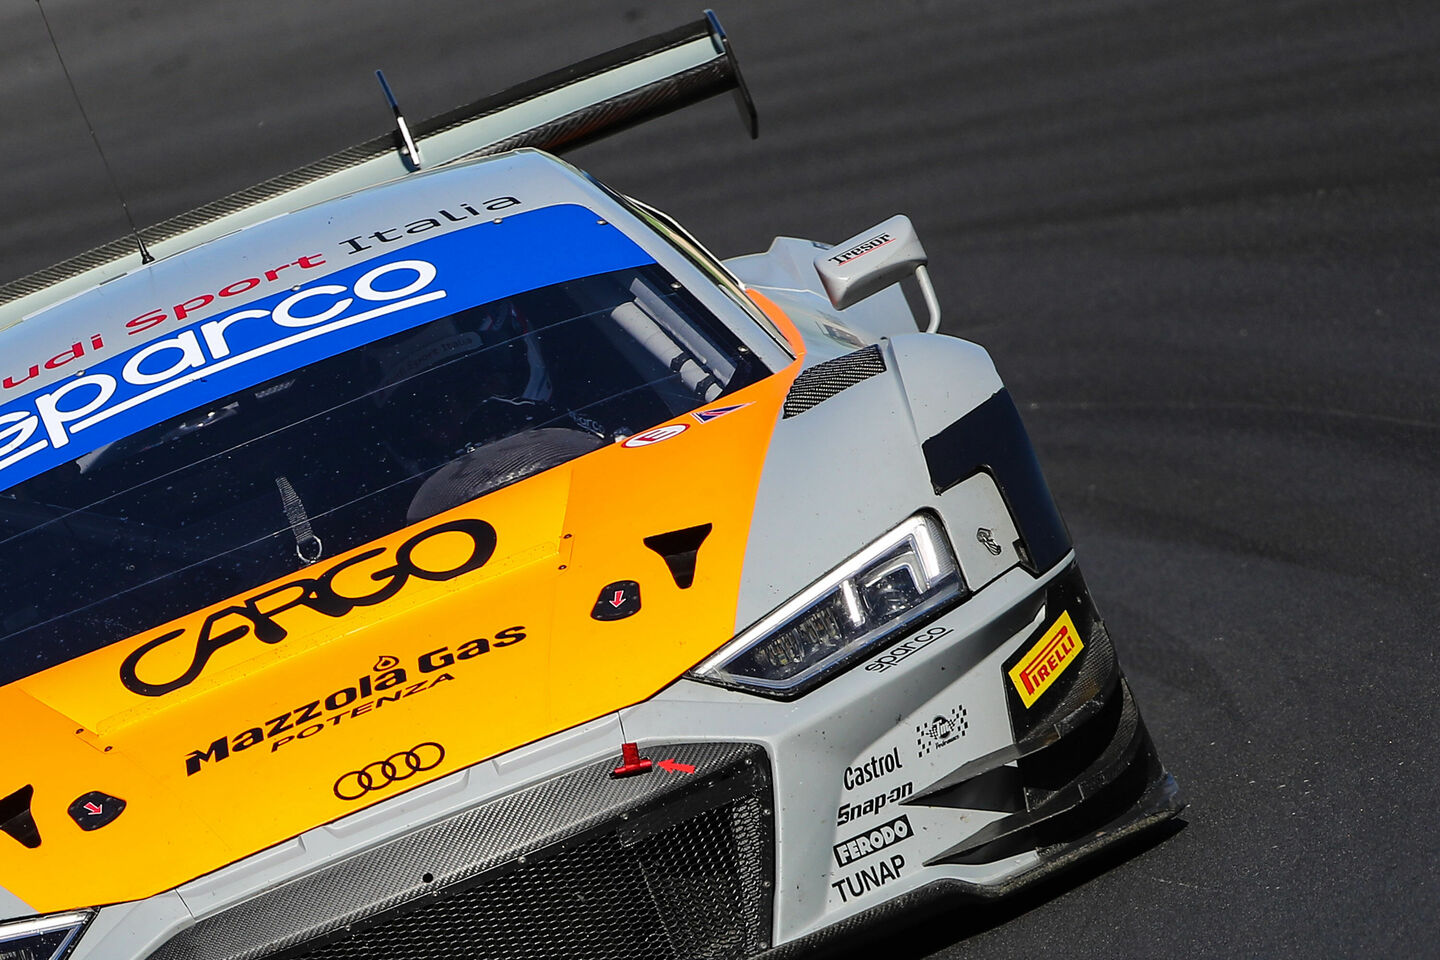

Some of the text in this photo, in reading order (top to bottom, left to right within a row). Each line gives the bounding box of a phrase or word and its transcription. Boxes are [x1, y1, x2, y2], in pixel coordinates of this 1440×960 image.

[126, 251, 327, 336] Sport
[336, 193, 523, 256] Italia
[828, 233, 896, 266] Tresor
[119, 518, 498, 697] CARGO
[417, 625, 527, 675] Gas
[865, 626, 953, 672] sparco
[1019, 625, 1075, 696] PIRELLI
[269, 673, 455, 753] POTENZA
[844, 747, 902, 791] Castrol
[837, 782, 913, 826] Snap-on
[836, 820, 910, 864] FERODO
[832, 854, 905, 902] TUNAP
